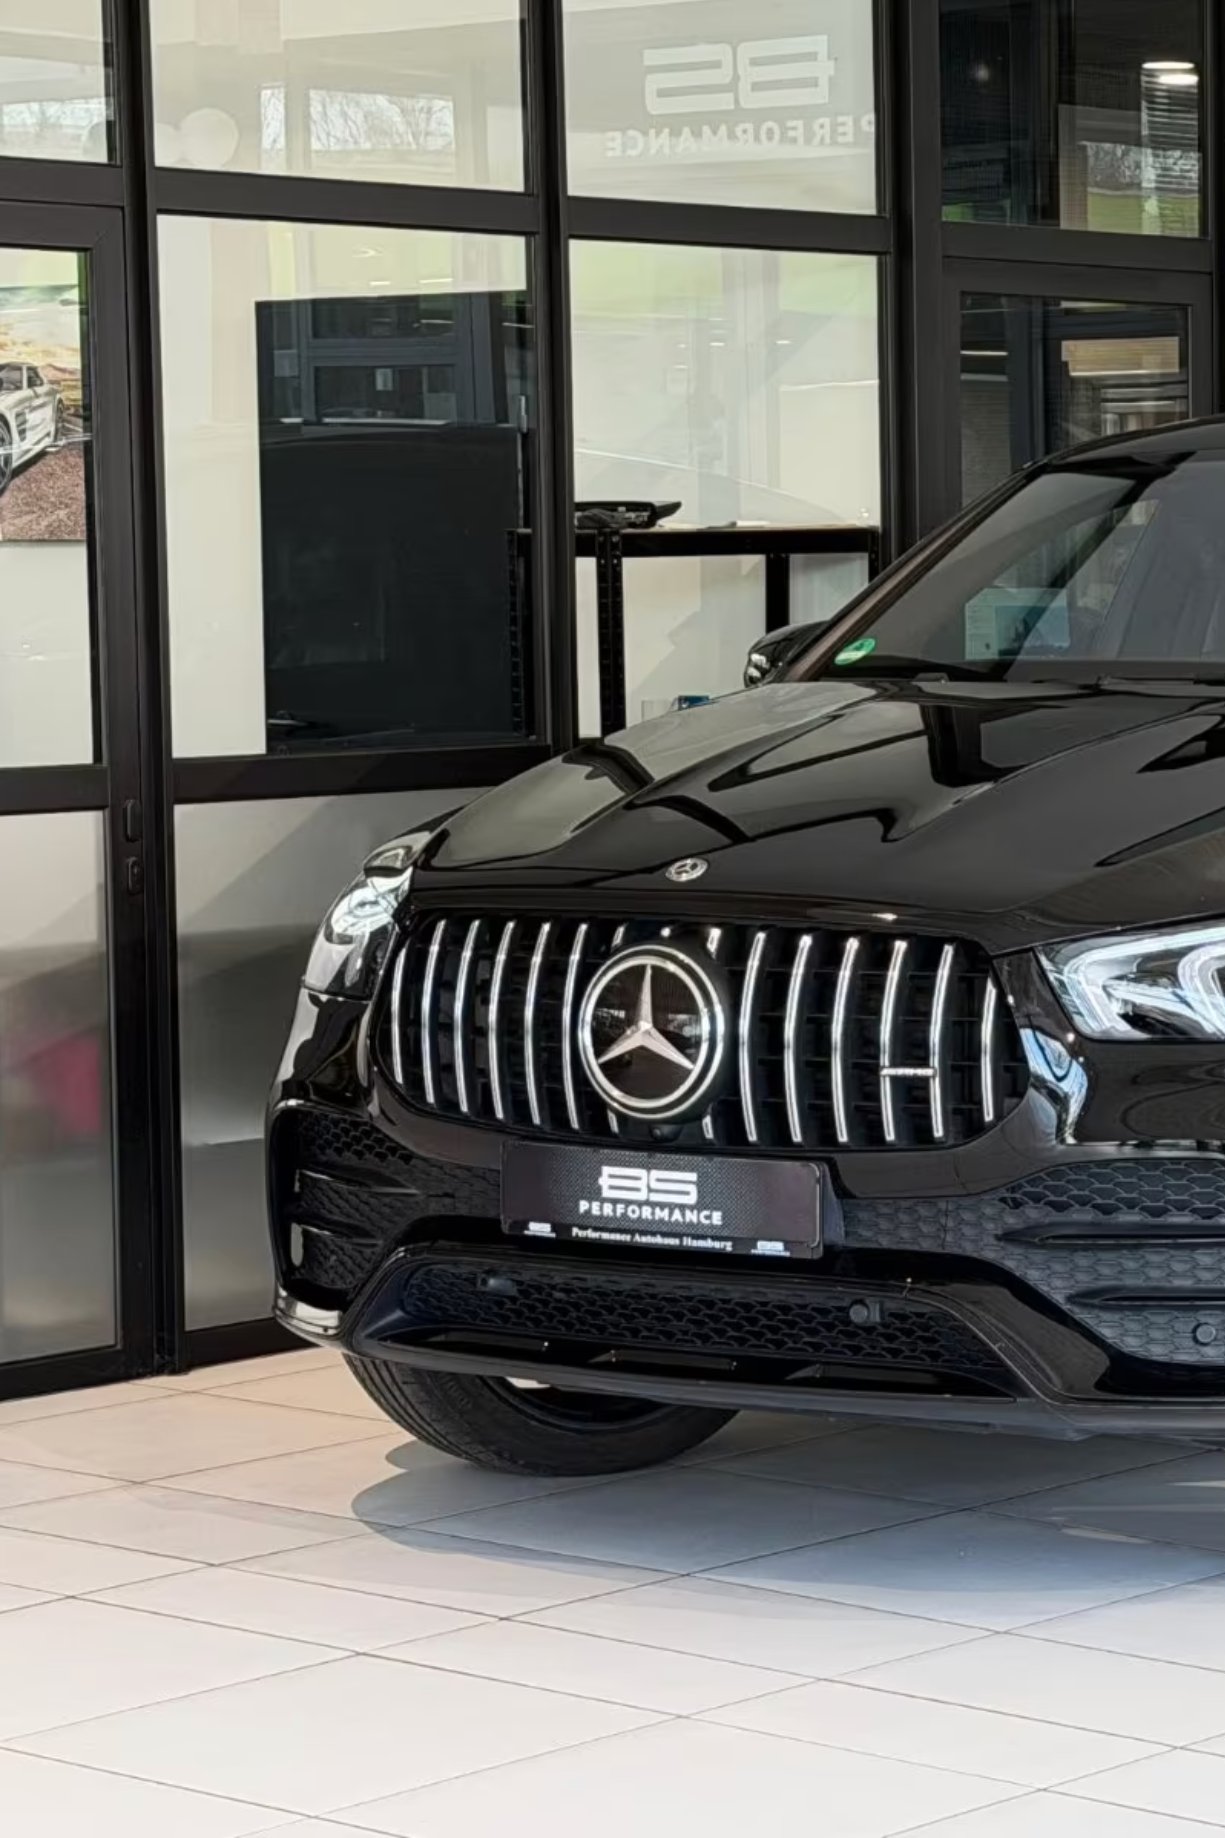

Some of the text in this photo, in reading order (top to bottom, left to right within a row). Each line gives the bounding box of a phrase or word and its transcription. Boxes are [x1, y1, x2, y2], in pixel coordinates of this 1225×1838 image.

[598, 1165, 698, 1205] BS
[579, 1200, 723, 1225] PERFORMANCE
[571, 1227, 631, 1242] Performance
[632, 1233, 681, 1246] Autohaus
[682, 1236, 733, 1251] Hamburg
